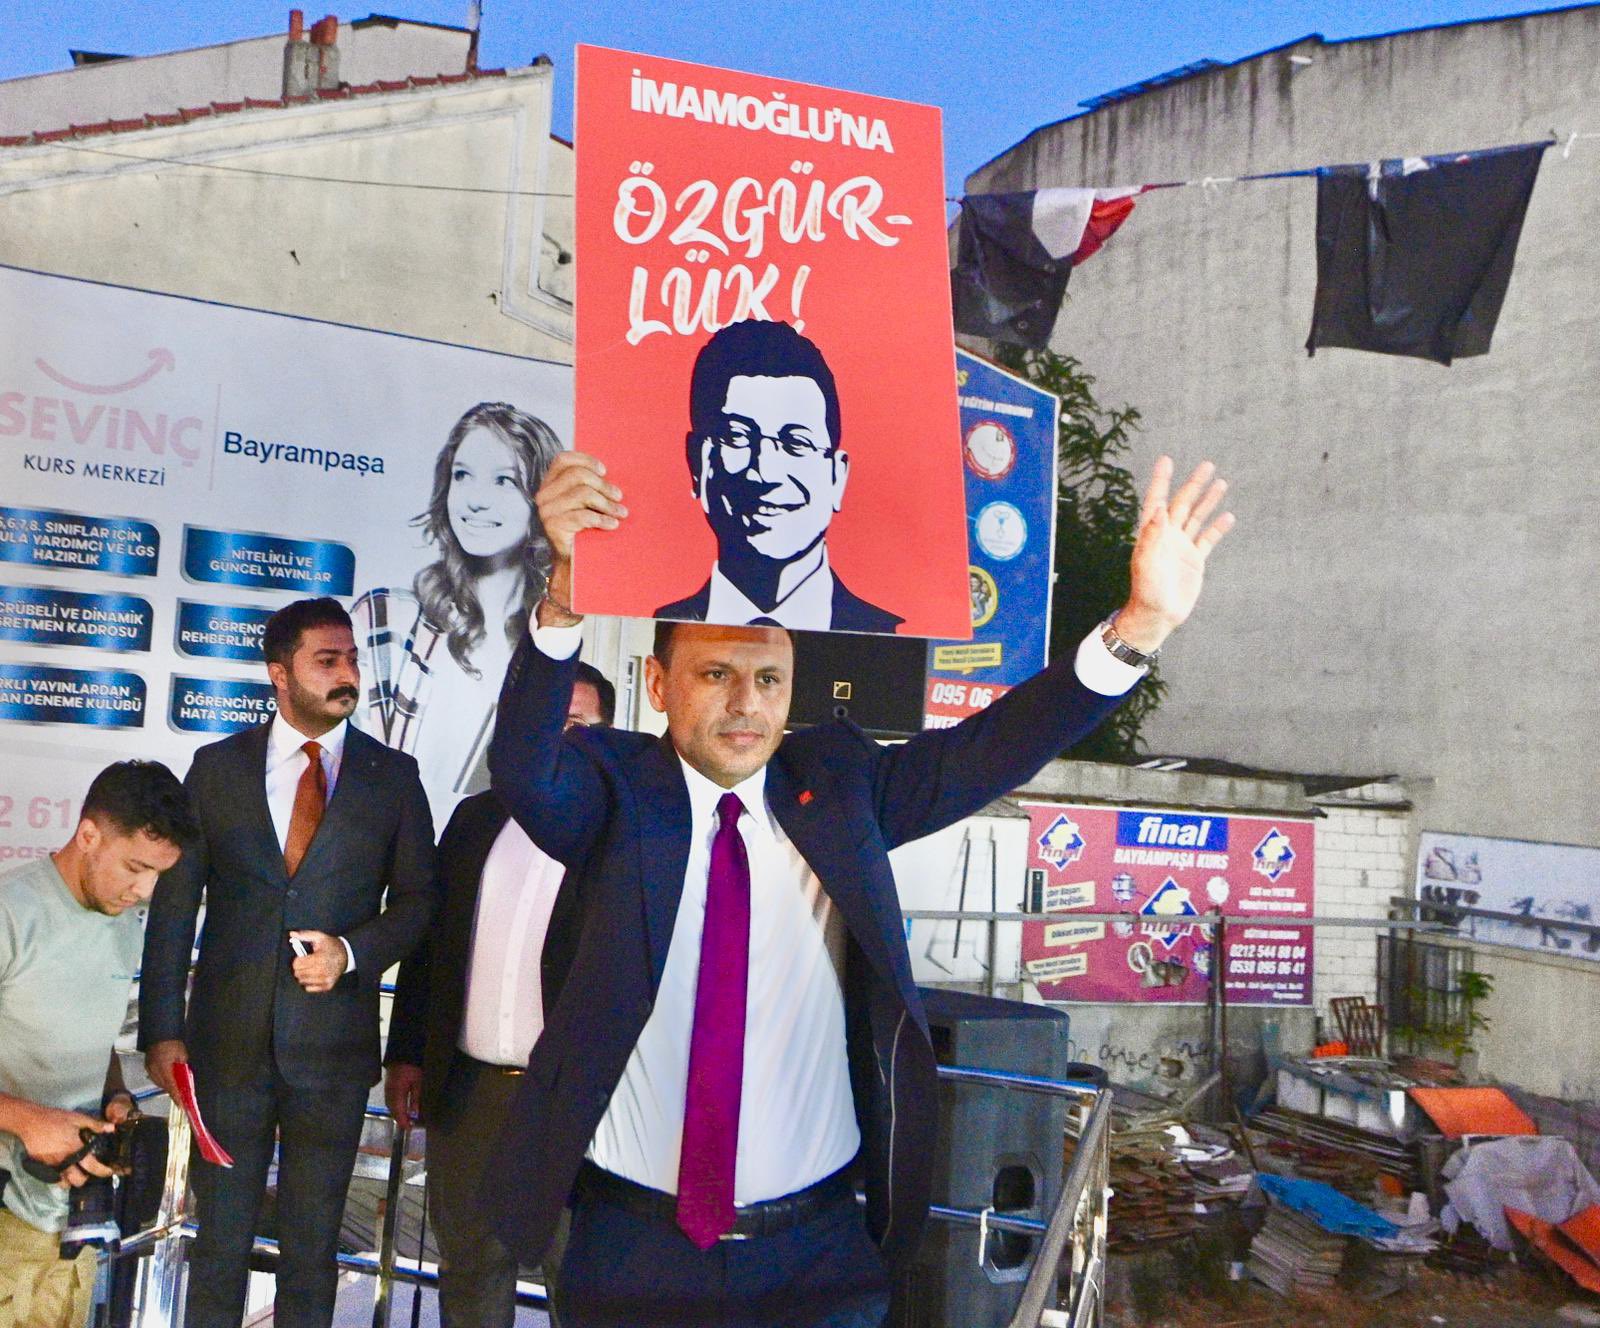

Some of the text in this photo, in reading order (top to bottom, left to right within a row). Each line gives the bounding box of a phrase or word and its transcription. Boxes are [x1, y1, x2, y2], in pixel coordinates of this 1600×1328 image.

[631, 69, 894, 153] İMAMOĞLU'NA
[223, 431, 385, 477] Bayrampaşa
[23, 453, 166, 486] KURS MERKEZİ
[45, 521, 110, 538] SINIFLAR
[33, 534, 103, 552] YARDIMCI
[107, 542, 125, 554] VE
[128, 545, 156, 558] LGS
[33, 548, 100, 565] HAZIRLIK
[231, 547, 313, 568] NİTELİKLİ VE
[209, 558, 332, 582] GÜNCEL YAYINLAR
[60, 607, 80, 620] VE
[82, 607, 144, 625] DİNAMİK
[67, 622, 137, 639] KADROSU
[181, 630, 255, 647] REHBERLİK
[30, 679, 130, 697] YAYINLARDAN
[931, 682, 967, 705] 095
[24, 694, 83, 709] DENEME
[86, 696, 142, 712] KULÜBÜ
[184, 690, 265, 710] ÖĞRENCİYE
[180, 708, 217, 721] HATA
[221, 710, 257, 723] SORU
[1137, 816, 1212, 847] final
[1113, 848, 1230, 870] BAYRAMPAŞA KURS
